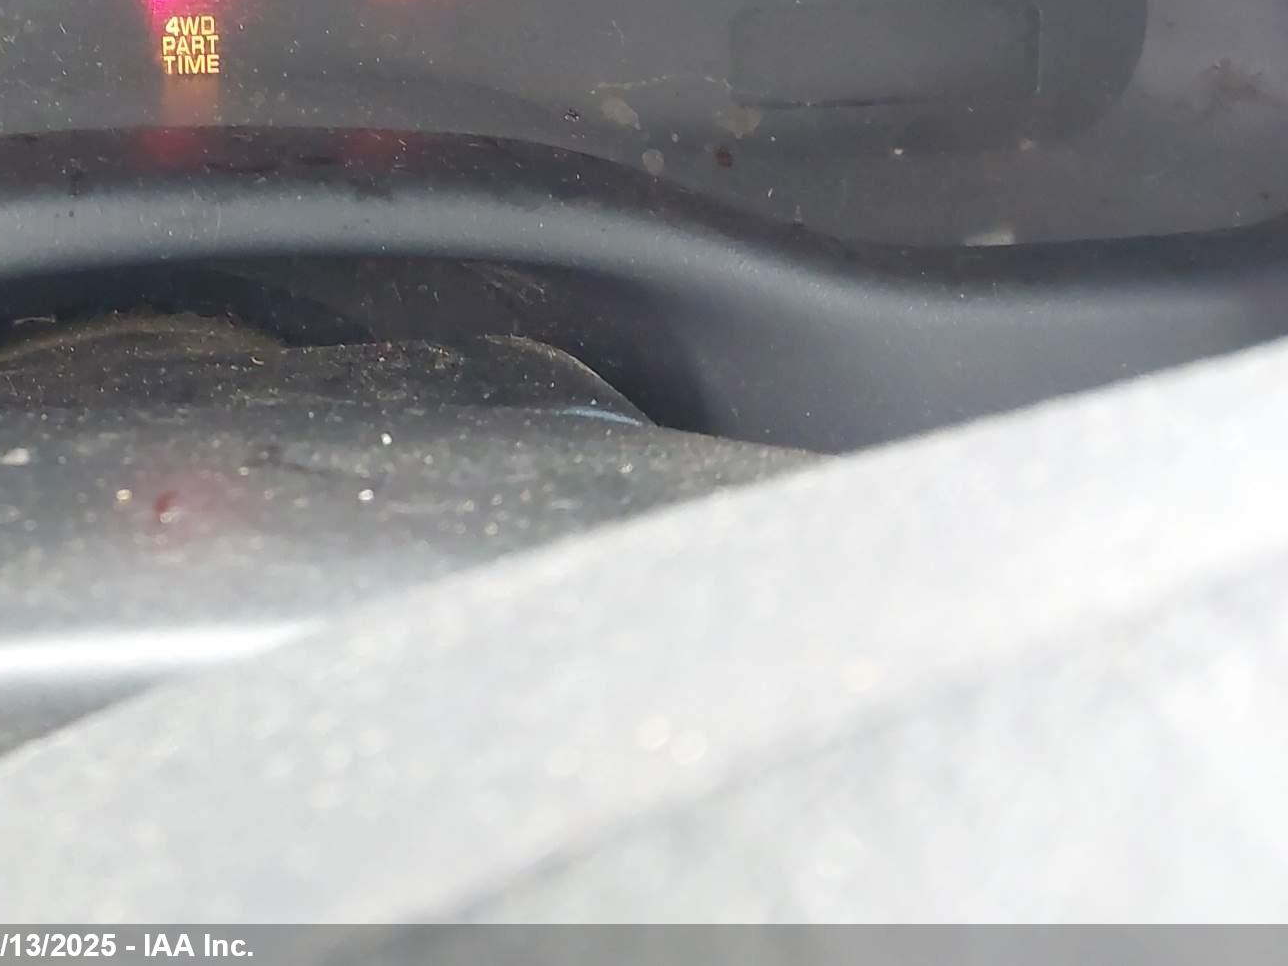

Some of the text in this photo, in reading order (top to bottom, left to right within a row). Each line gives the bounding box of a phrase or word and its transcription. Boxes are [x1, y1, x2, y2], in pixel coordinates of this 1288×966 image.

[165, 15, 215, 36] 4WD
[163, 34, 219, 56] PART
[164, 54, 220, 74] TIME
